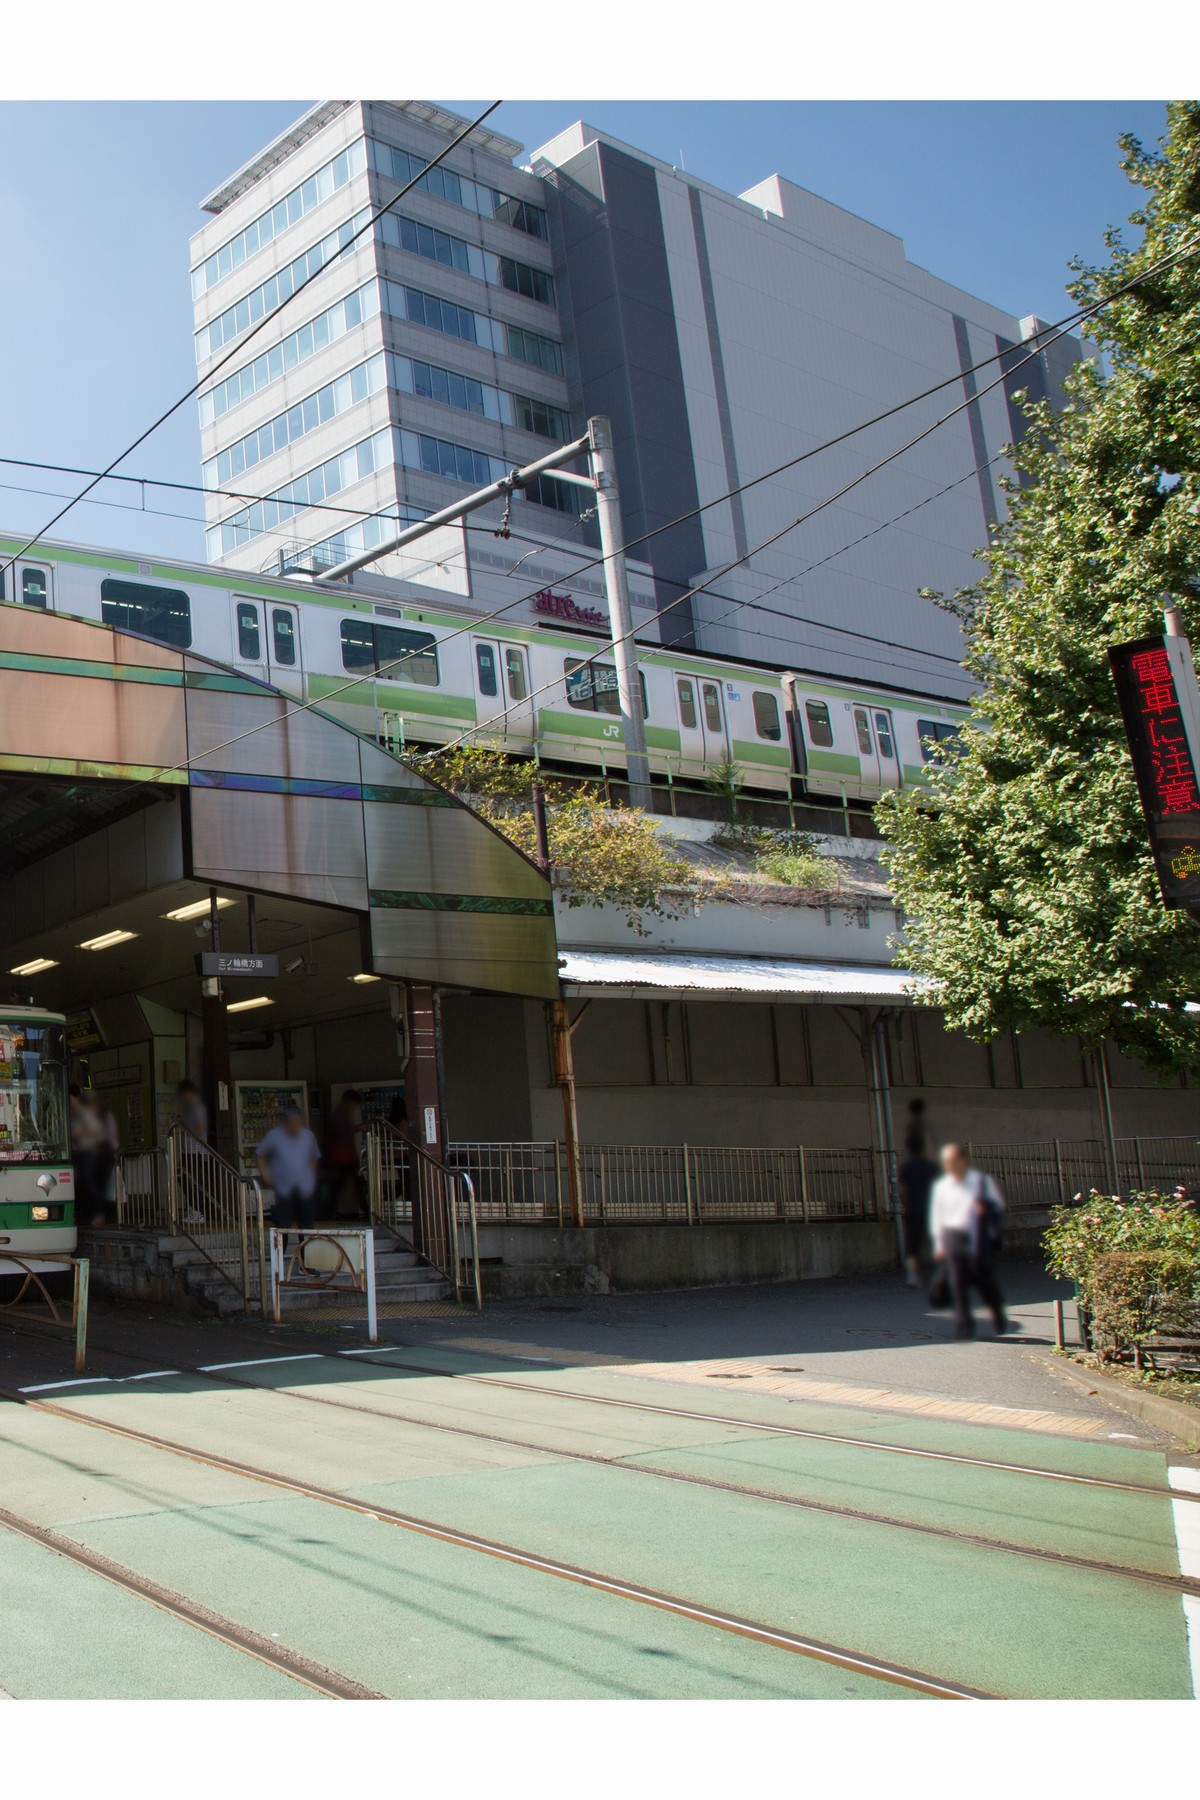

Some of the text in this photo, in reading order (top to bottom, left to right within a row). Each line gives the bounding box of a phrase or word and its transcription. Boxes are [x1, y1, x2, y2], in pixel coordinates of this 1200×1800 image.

[535, 589, 575, 617] atré
[603, 725, 619, 738] JR
[1131, 648, 1200, 816] 電車に注意
[218, 958, 263, 968] 三ノ輪橋方面
